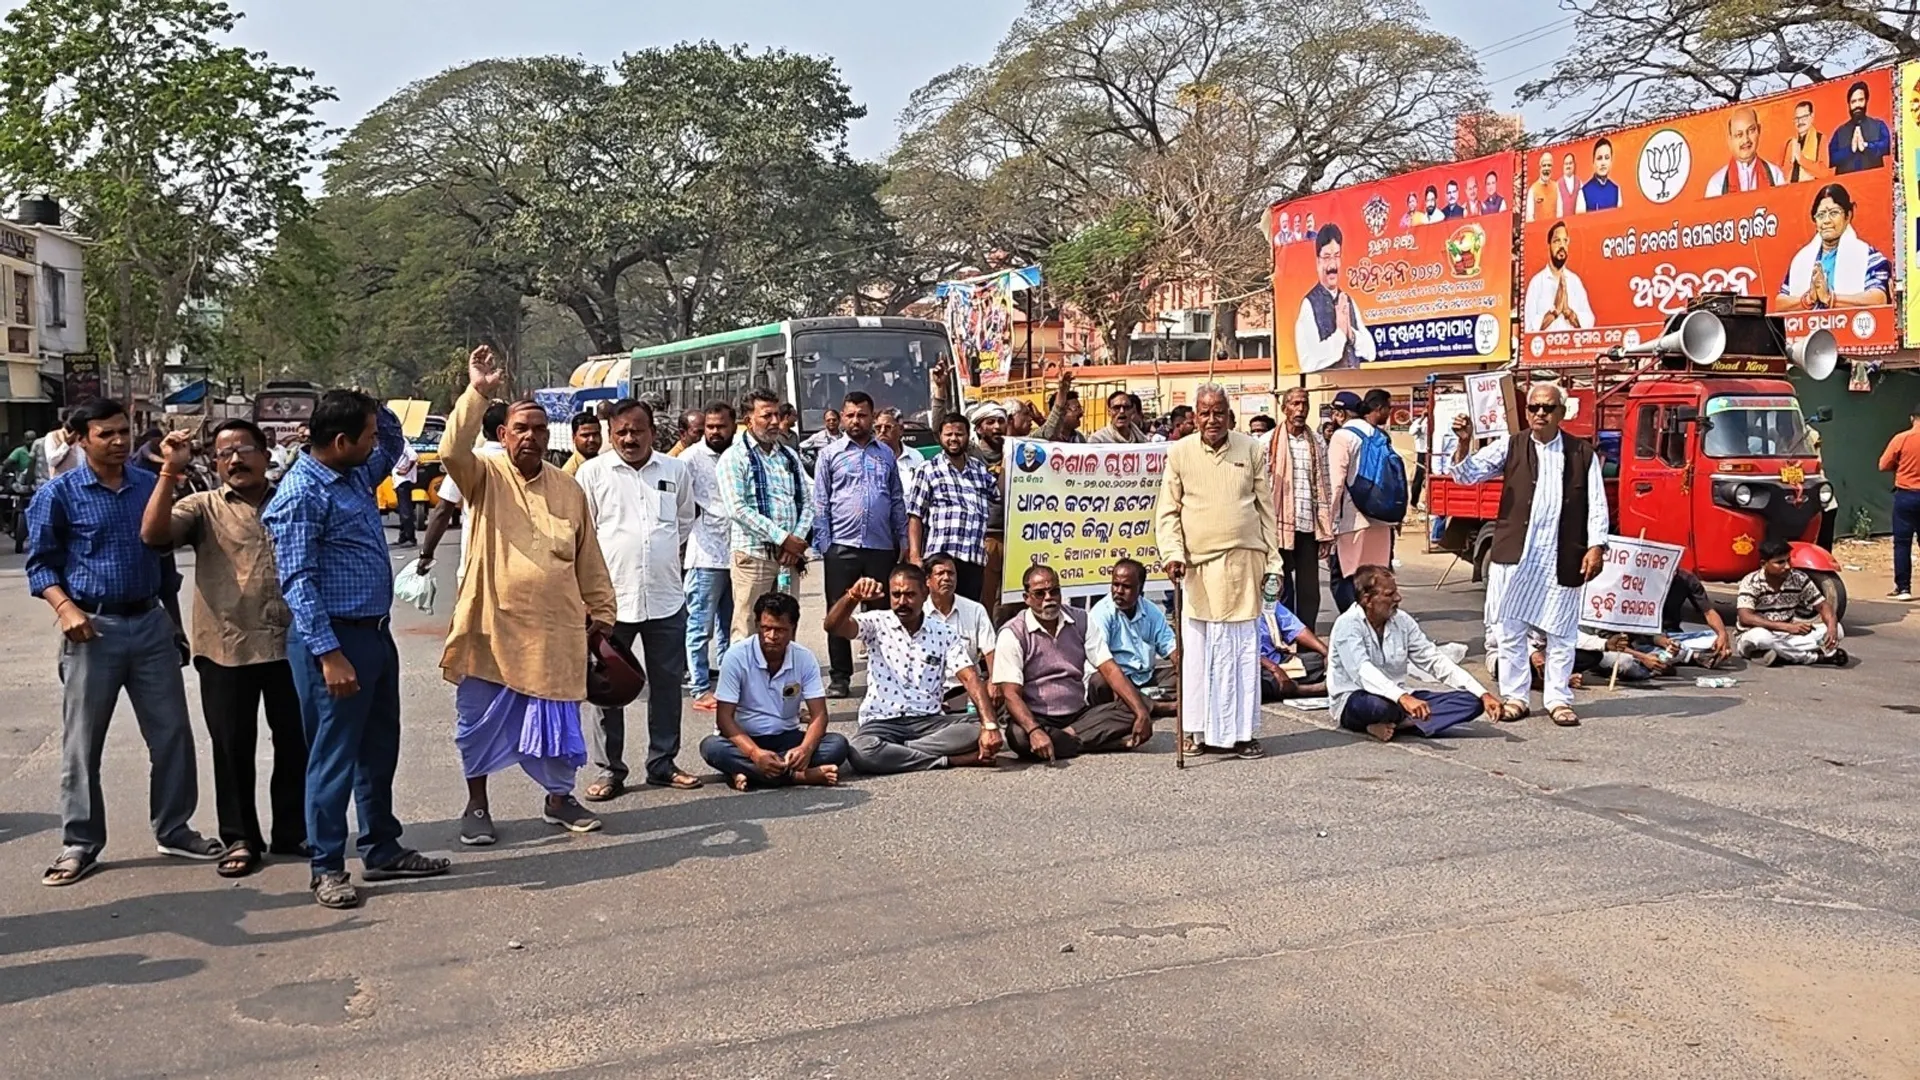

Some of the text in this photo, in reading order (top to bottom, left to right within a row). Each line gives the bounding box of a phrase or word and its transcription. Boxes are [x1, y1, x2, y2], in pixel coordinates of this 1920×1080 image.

[1639, 220, 1680, 254] ନବବର୍ଷ
[1682, 219, 1735, 248] ଉପଲକ୍ଷେ
[1347, 257, 1409, 293] ଅଭିନନ୍ଦନ
[1426, 319, 1473, 341] ମହାପାତ୍ର
[1572, 331, 1601, 348] କୁମାର
[1712, 361, 1769, 373] Road King
[1050, 447, 1098, 474] ବିଶାଳ
[1017, 494, 1156, 512] ଧାନର କଟନୀ ଛଟନୀ
[1021, 521, 1076, 544] ଯାଜପୁର
[1081, 517, 1115, 544] ଜିଲ୍ଲା
